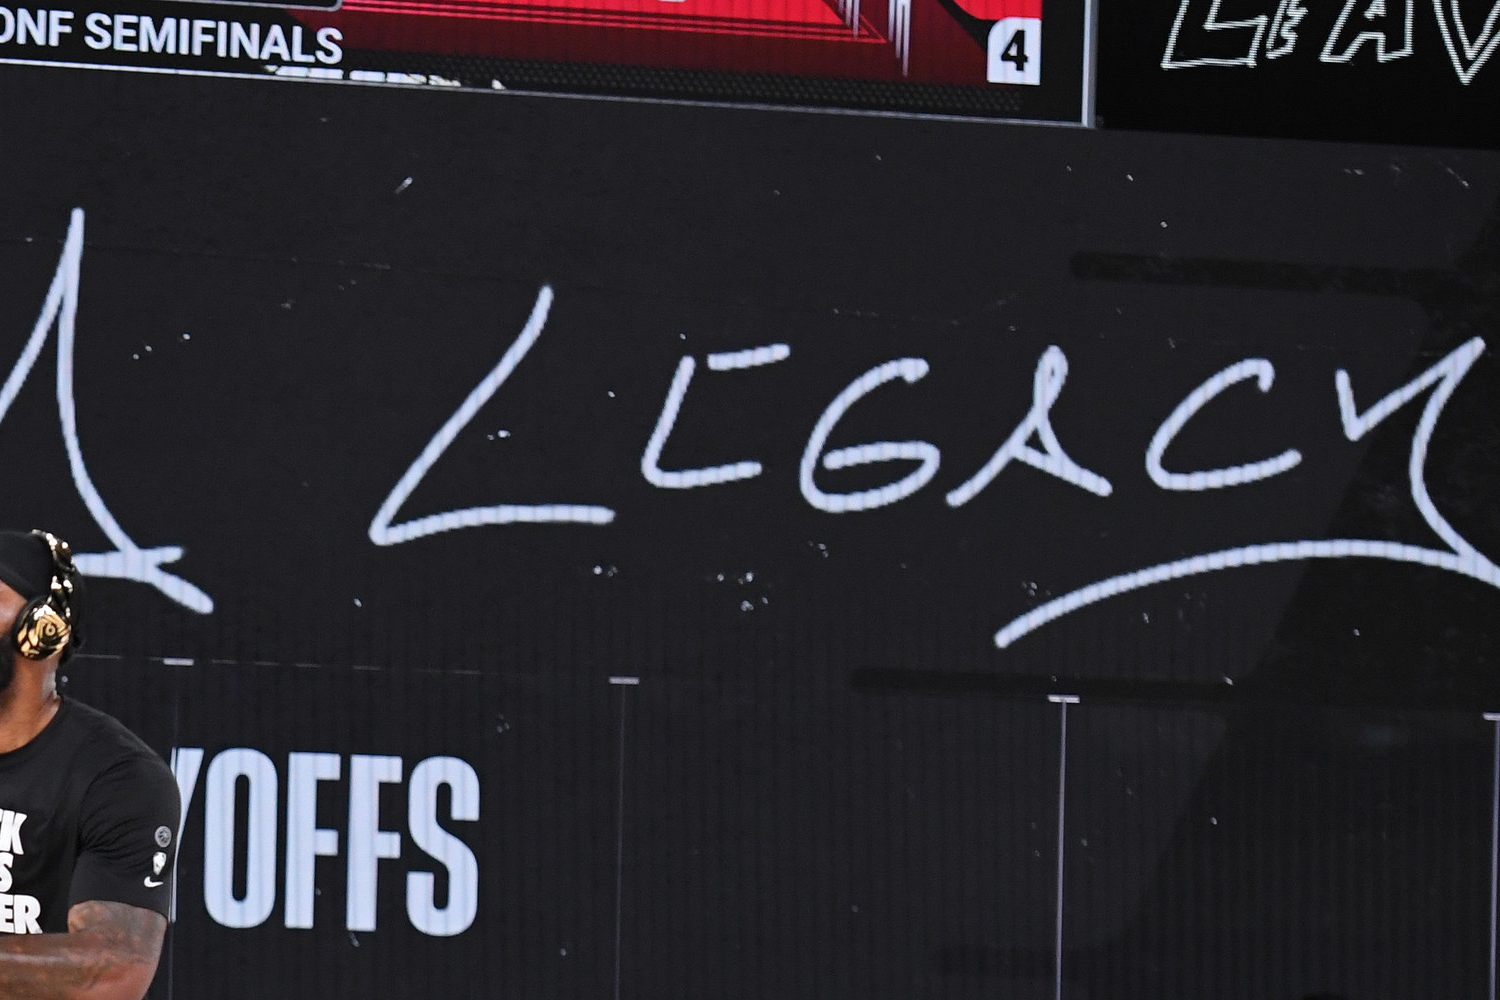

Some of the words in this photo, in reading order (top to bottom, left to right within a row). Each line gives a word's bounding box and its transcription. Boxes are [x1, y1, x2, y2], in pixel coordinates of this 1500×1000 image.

[84, 15, 344, 65] SEMIFINALS
[1000, 29, 1029, 72] 4
[367, 283, 1500, 648] LEGACY
